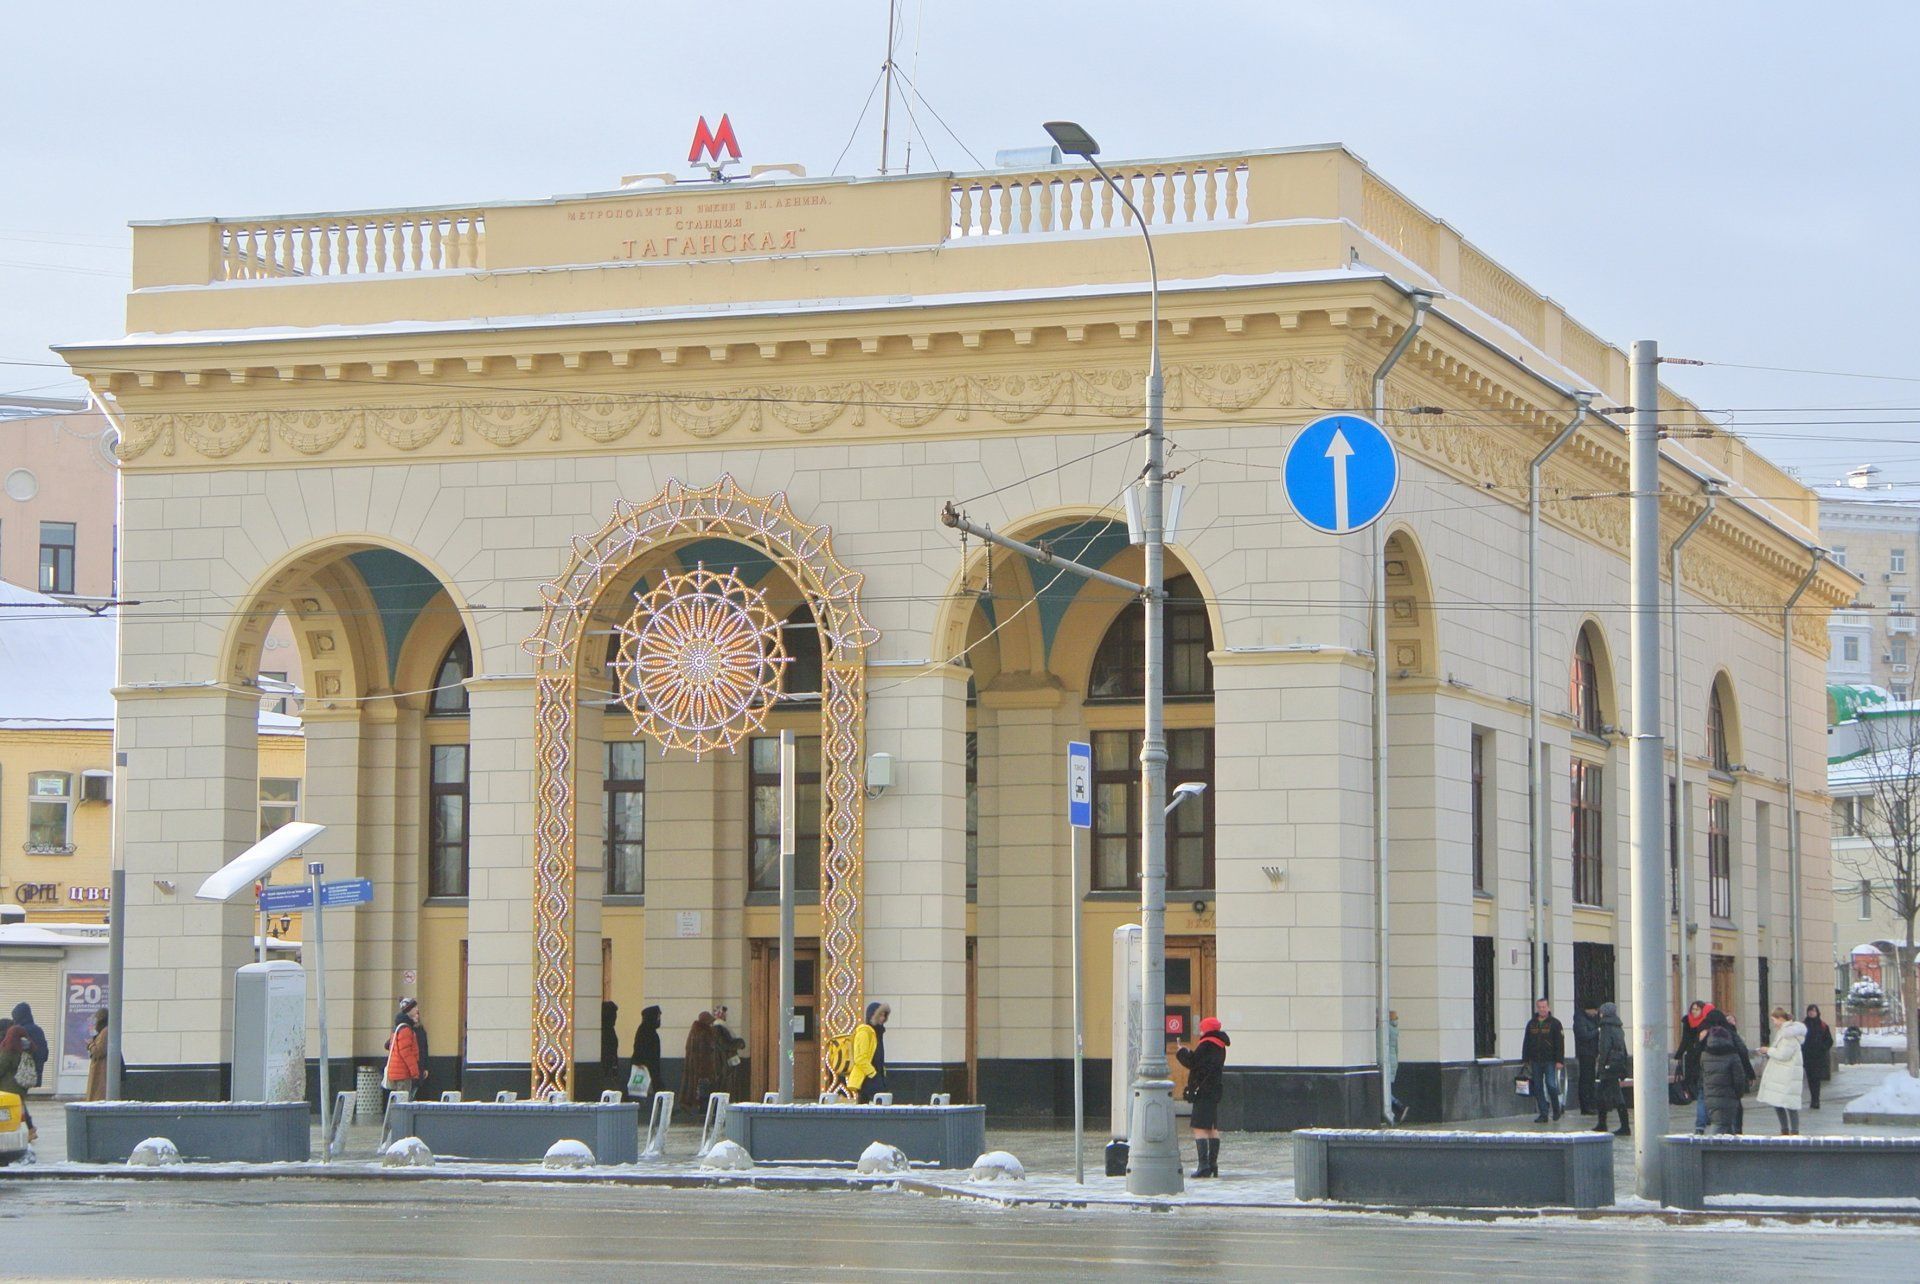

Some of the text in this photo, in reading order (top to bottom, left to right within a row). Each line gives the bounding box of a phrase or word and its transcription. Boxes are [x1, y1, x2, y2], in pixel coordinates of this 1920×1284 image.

[687, 112, 743, 163] М
[567, 206, 683, 221] МЕТРОПОЛИТЕН
[696, 202, 737, 214] ИМЕНИ
[675, 217, 743, 231] СТАНЦИЯ
[69, 984, 101, 1004] 20
